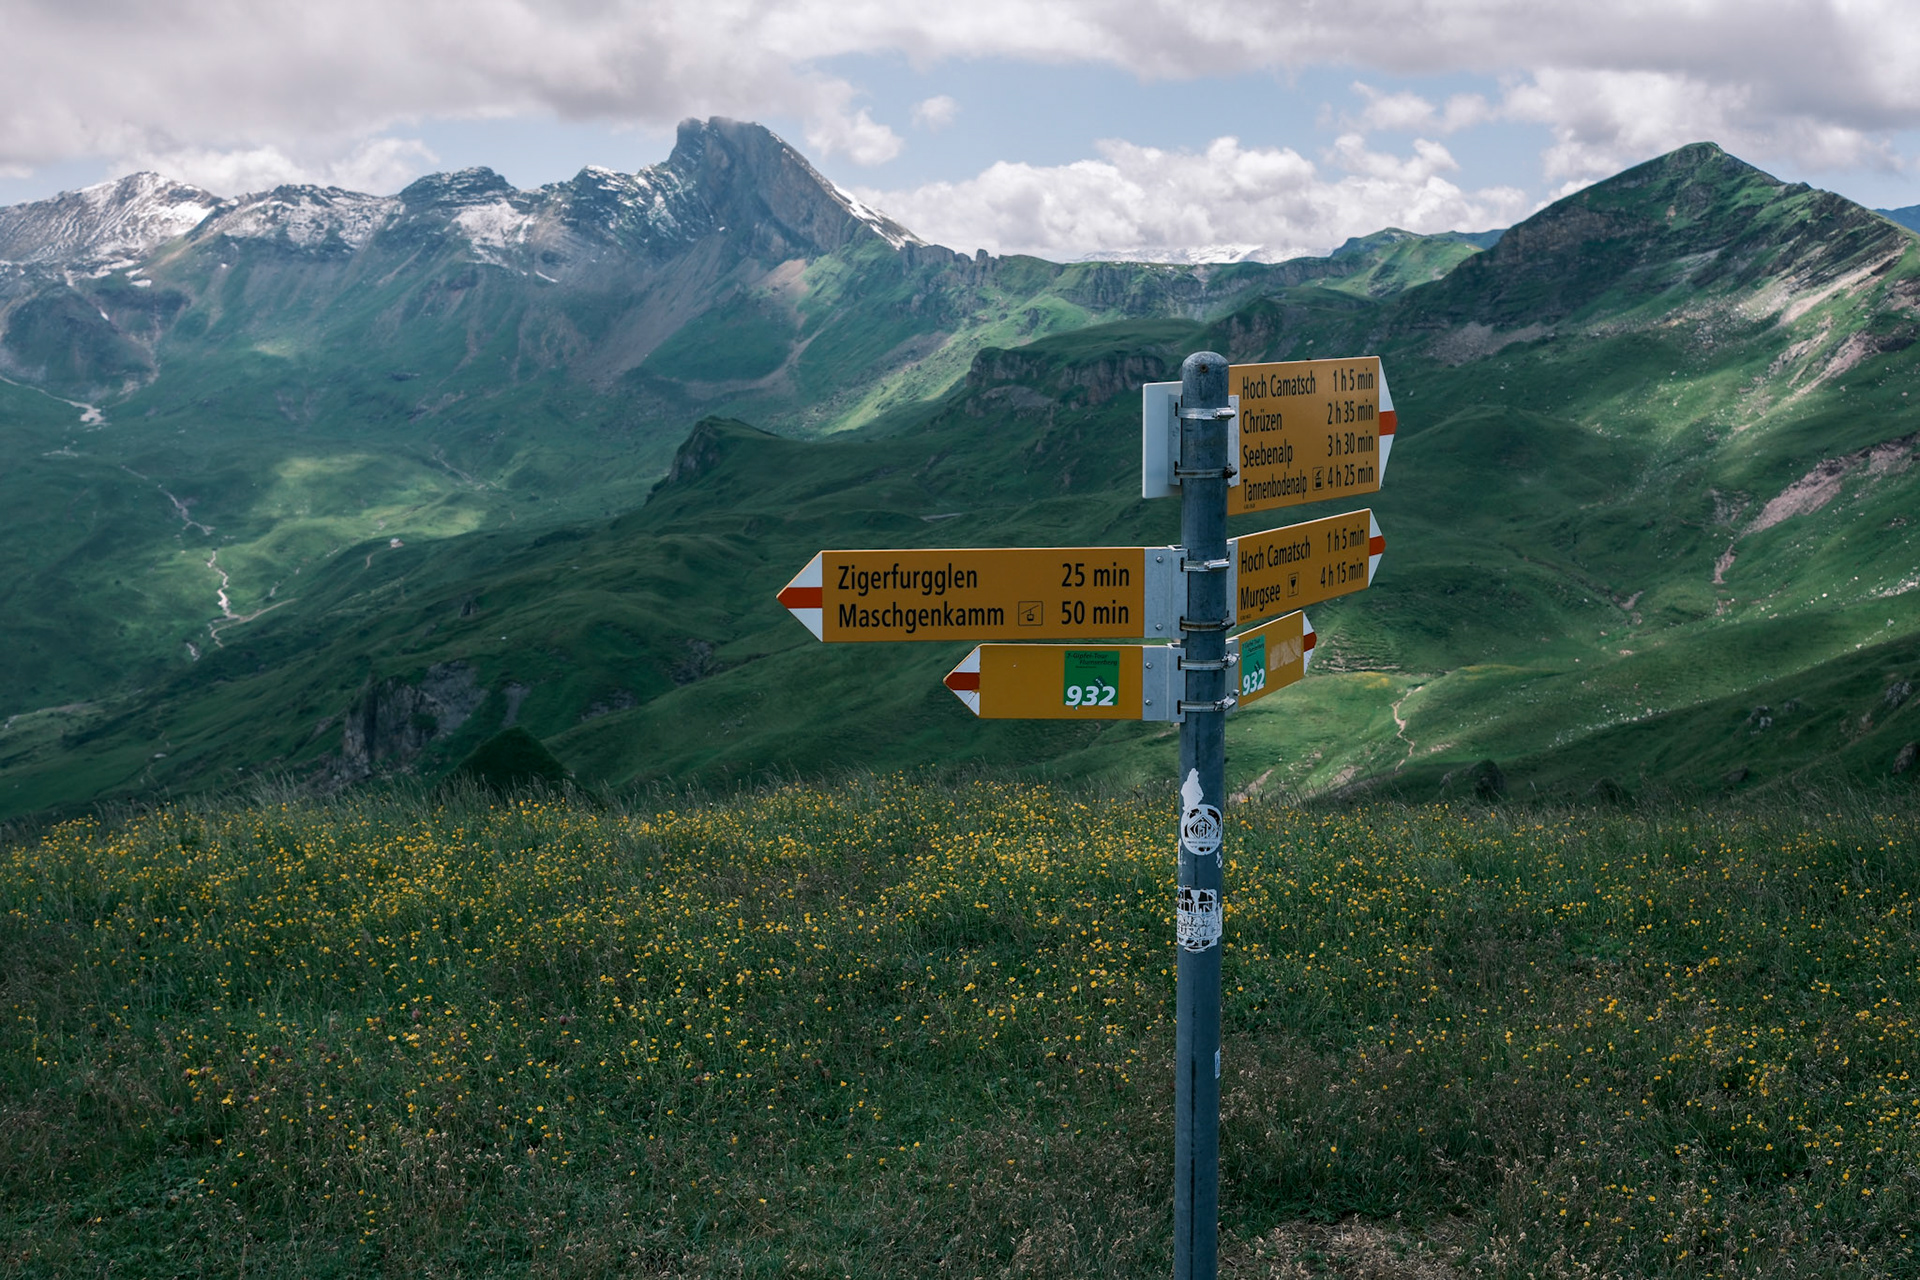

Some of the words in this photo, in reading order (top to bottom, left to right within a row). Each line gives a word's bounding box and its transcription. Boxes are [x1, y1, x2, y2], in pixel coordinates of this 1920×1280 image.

[1242, 373, 1267, 400] Hoch
[1270, 370, 1316, 397] Camatsch
[1333, 370, 1338, 392] 1
[1341, 368, 1347, 391] h
[1349, 369, 1355, 391] 5
[1357, 367, 1374, 390] min
[1242, 409, 1283, 434] Chrüzen
[1327, 403, 1333, 425] 2
[1335, 401, 1341, 424] h
[1344, 401, 1355, 423] 35
[1357, 399, 1374, 422] min
[1243, 439, 1293, 468] Seebenalp
[1327, 435, 1333, 457] 3
[1335, 433, 1341, 455] h
[1344, 433, 1355, 455] 30
[1357, 431, 1374, 453] min
[1243, 470, 1307, 502] Tannenbodenalp
[1327, 467, 1333, 489] 4
[1335, 465, 1341, 487] h
[1344, 464, 1355, 486] 25
[1357, 462, 1374, 484] min
[1240, 546, 1264, 574] Hoch
[1267, 536, 1311, 568] Camatsch
[1326, 532, 1331, 553] 1
[1334, 529, 1340, 552] h
[1342, 529, 1347, 550] 5
[1349, 524, 1364, 548] min
[838, 562, 978, 595] Zigerfurgglen
[1061, 562, 1086, 587] 25
[1093, 562, 1130, 587] min
[1240, 583, 1281, 612] Murgsee
[1320, 567, 1326, 588] 4
[1328, 564, 1334, 586] h
[1336, 562, 1347, 585] 15
[1348, 558, 1364, 581] min
[838, 601, 1005, 633] Maschgenkamm
[1061, 600, 1085, 625] 50
[1093, 599, 1129, 624] min
[1065, 685, 1116, 706] 932
[1242, 667, 1265, 696] 932
